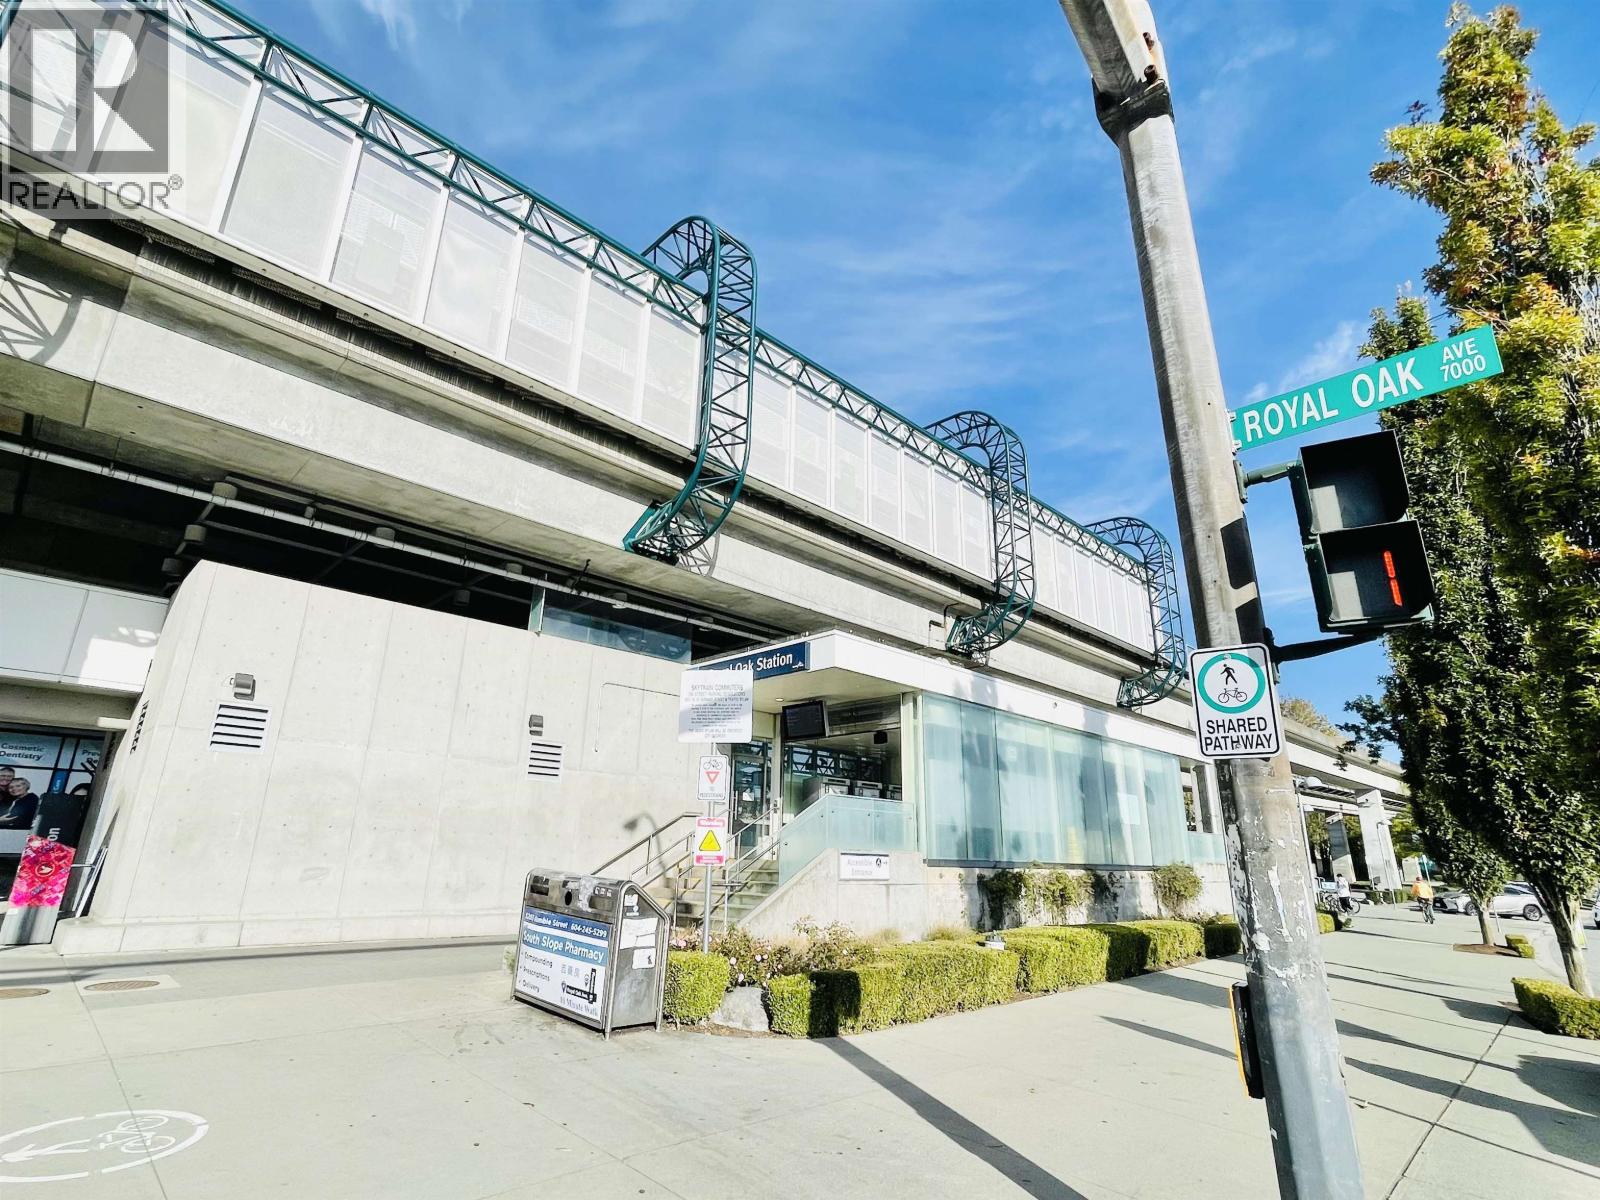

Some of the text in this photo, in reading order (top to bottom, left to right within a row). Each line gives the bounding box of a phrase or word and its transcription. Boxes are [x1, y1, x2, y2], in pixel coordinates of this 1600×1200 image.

[1440, 354, 1486, 382] 7000
[1243, 337, 1479, 442] ROYAL OAK AVE
[756, 653, 793, 671] Station
[1204, 716, 1272, 751] SHARED PATHWAY
[0, 751, 43, 761] Dentistry
[1, 743, 45, 752] Cosmetic
[553, 920, 569, 929] Street
[523, 930, 604, 963] South Slope Pharmacy
